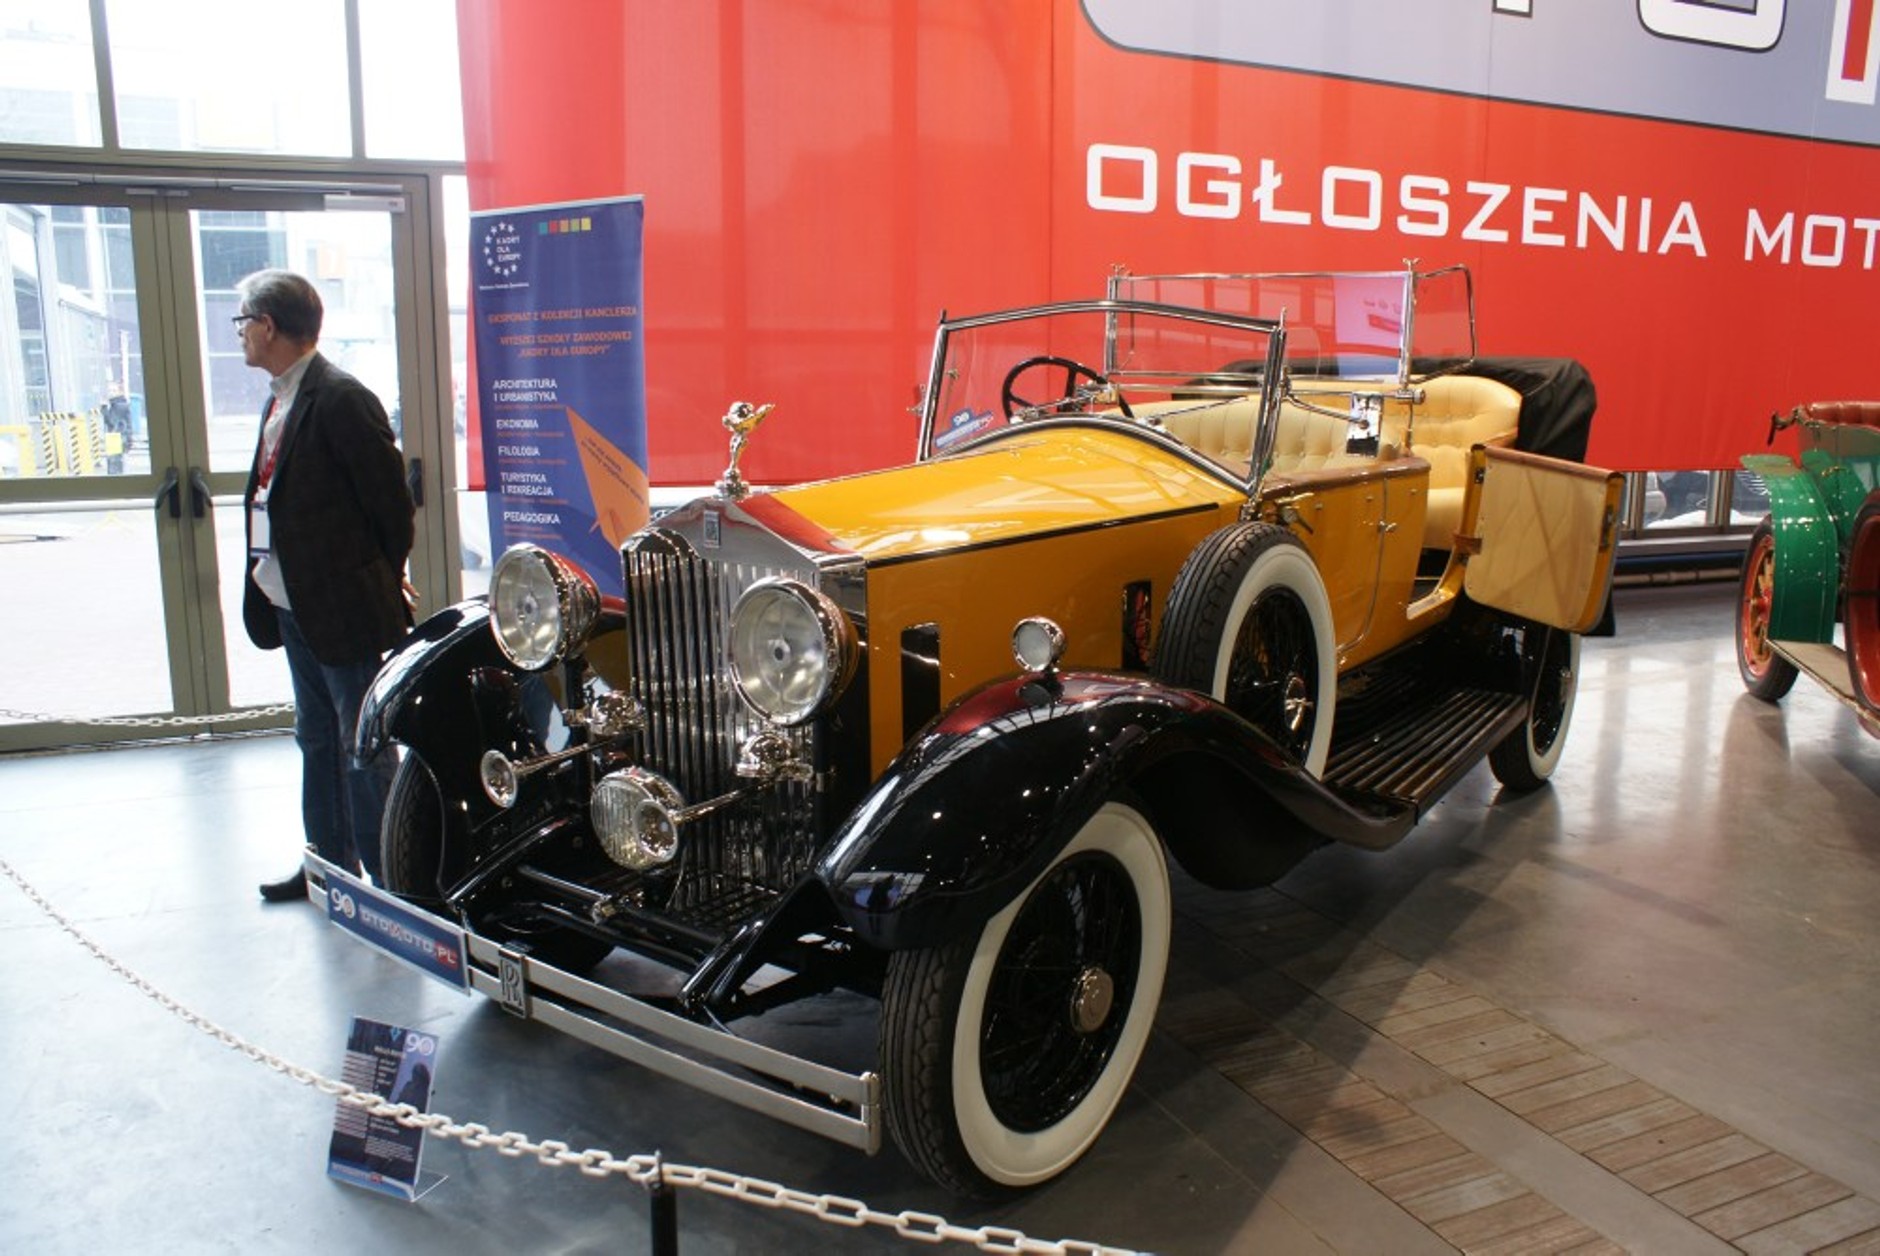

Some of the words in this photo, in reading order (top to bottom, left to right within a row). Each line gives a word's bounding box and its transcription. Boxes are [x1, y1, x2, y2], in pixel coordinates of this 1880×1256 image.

[1086, 143, 1707, 257] OGŁOSZENIA
[1744, 208, 1880, 269] MOT
[585, 306, 637, 318] KANCLERZA
[573, 330, 632, 343] ZAWODOWEJ
[493, 378, 558, 390] ARCHITEKTURA
[500, 391, 558, 402] URBANISTYKA
[496, 419, 539, 430] EKONOMIA
[498, 446, 541, 457] FILOLOGIA
[500, 472, 547, 483] TURYSTYKA
[507, 485, 554, 496] REKREACJA
[503, 511, 561, 524] PEDAGOGIKA
[331, 887, 356, 919] 90
[405, 1033, 435, 1056] 90
